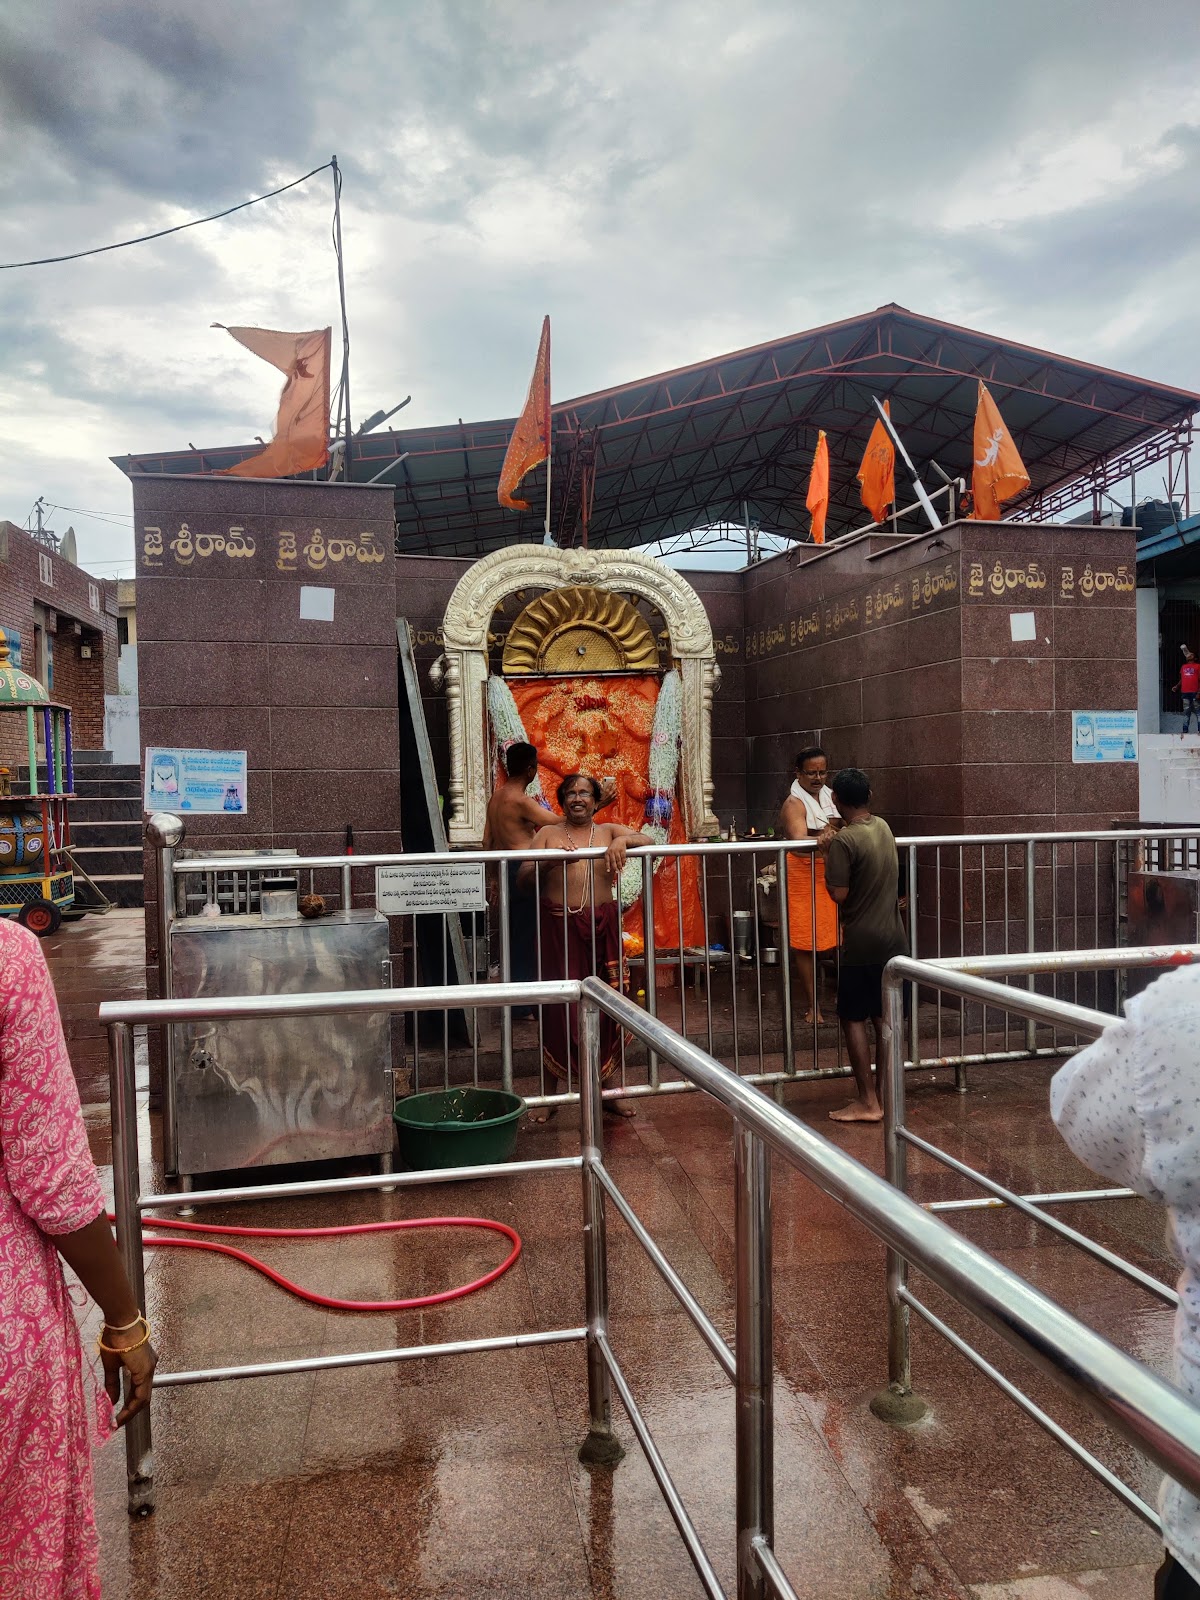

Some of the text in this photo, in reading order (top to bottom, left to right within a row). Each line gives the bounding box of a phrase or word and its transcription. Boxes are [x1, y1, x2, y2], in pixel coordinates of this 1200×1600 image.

[142, 523, 386, 571] జై శ్రీరామ్ జై శ్రీరామ్
[865, 596, 873, 624] జై
[874, 584, 905, 619] శ్రీరామ్
[911, 579, 921, 610] జై
[921, 565, 958, 604] శ్రీరామ్
[968, 560, 1135, 598] జై శ్రీరామ్ జై శ్రీరామ్
